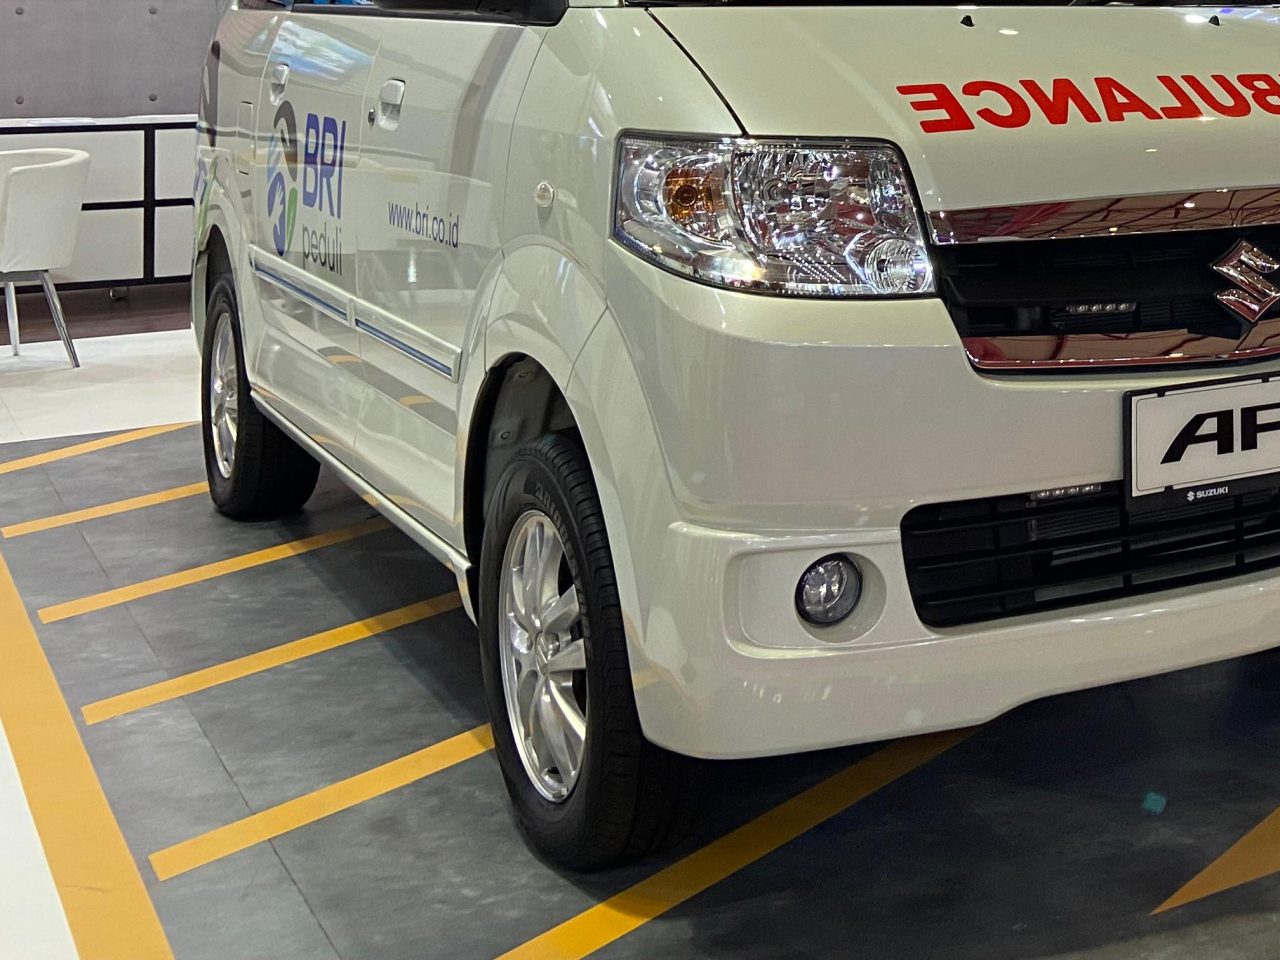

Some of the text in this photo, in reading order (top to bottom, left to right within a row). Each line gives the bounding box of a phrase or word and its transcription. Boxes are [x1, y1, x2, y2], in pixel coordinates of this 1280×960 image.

[302, 113, 347, 220] BRI
[301, 221, 344, 276] peduli
[388, 200, 460, 249] www.bri.co.id
[1196, 486, 1229, 499] SUZUKI
